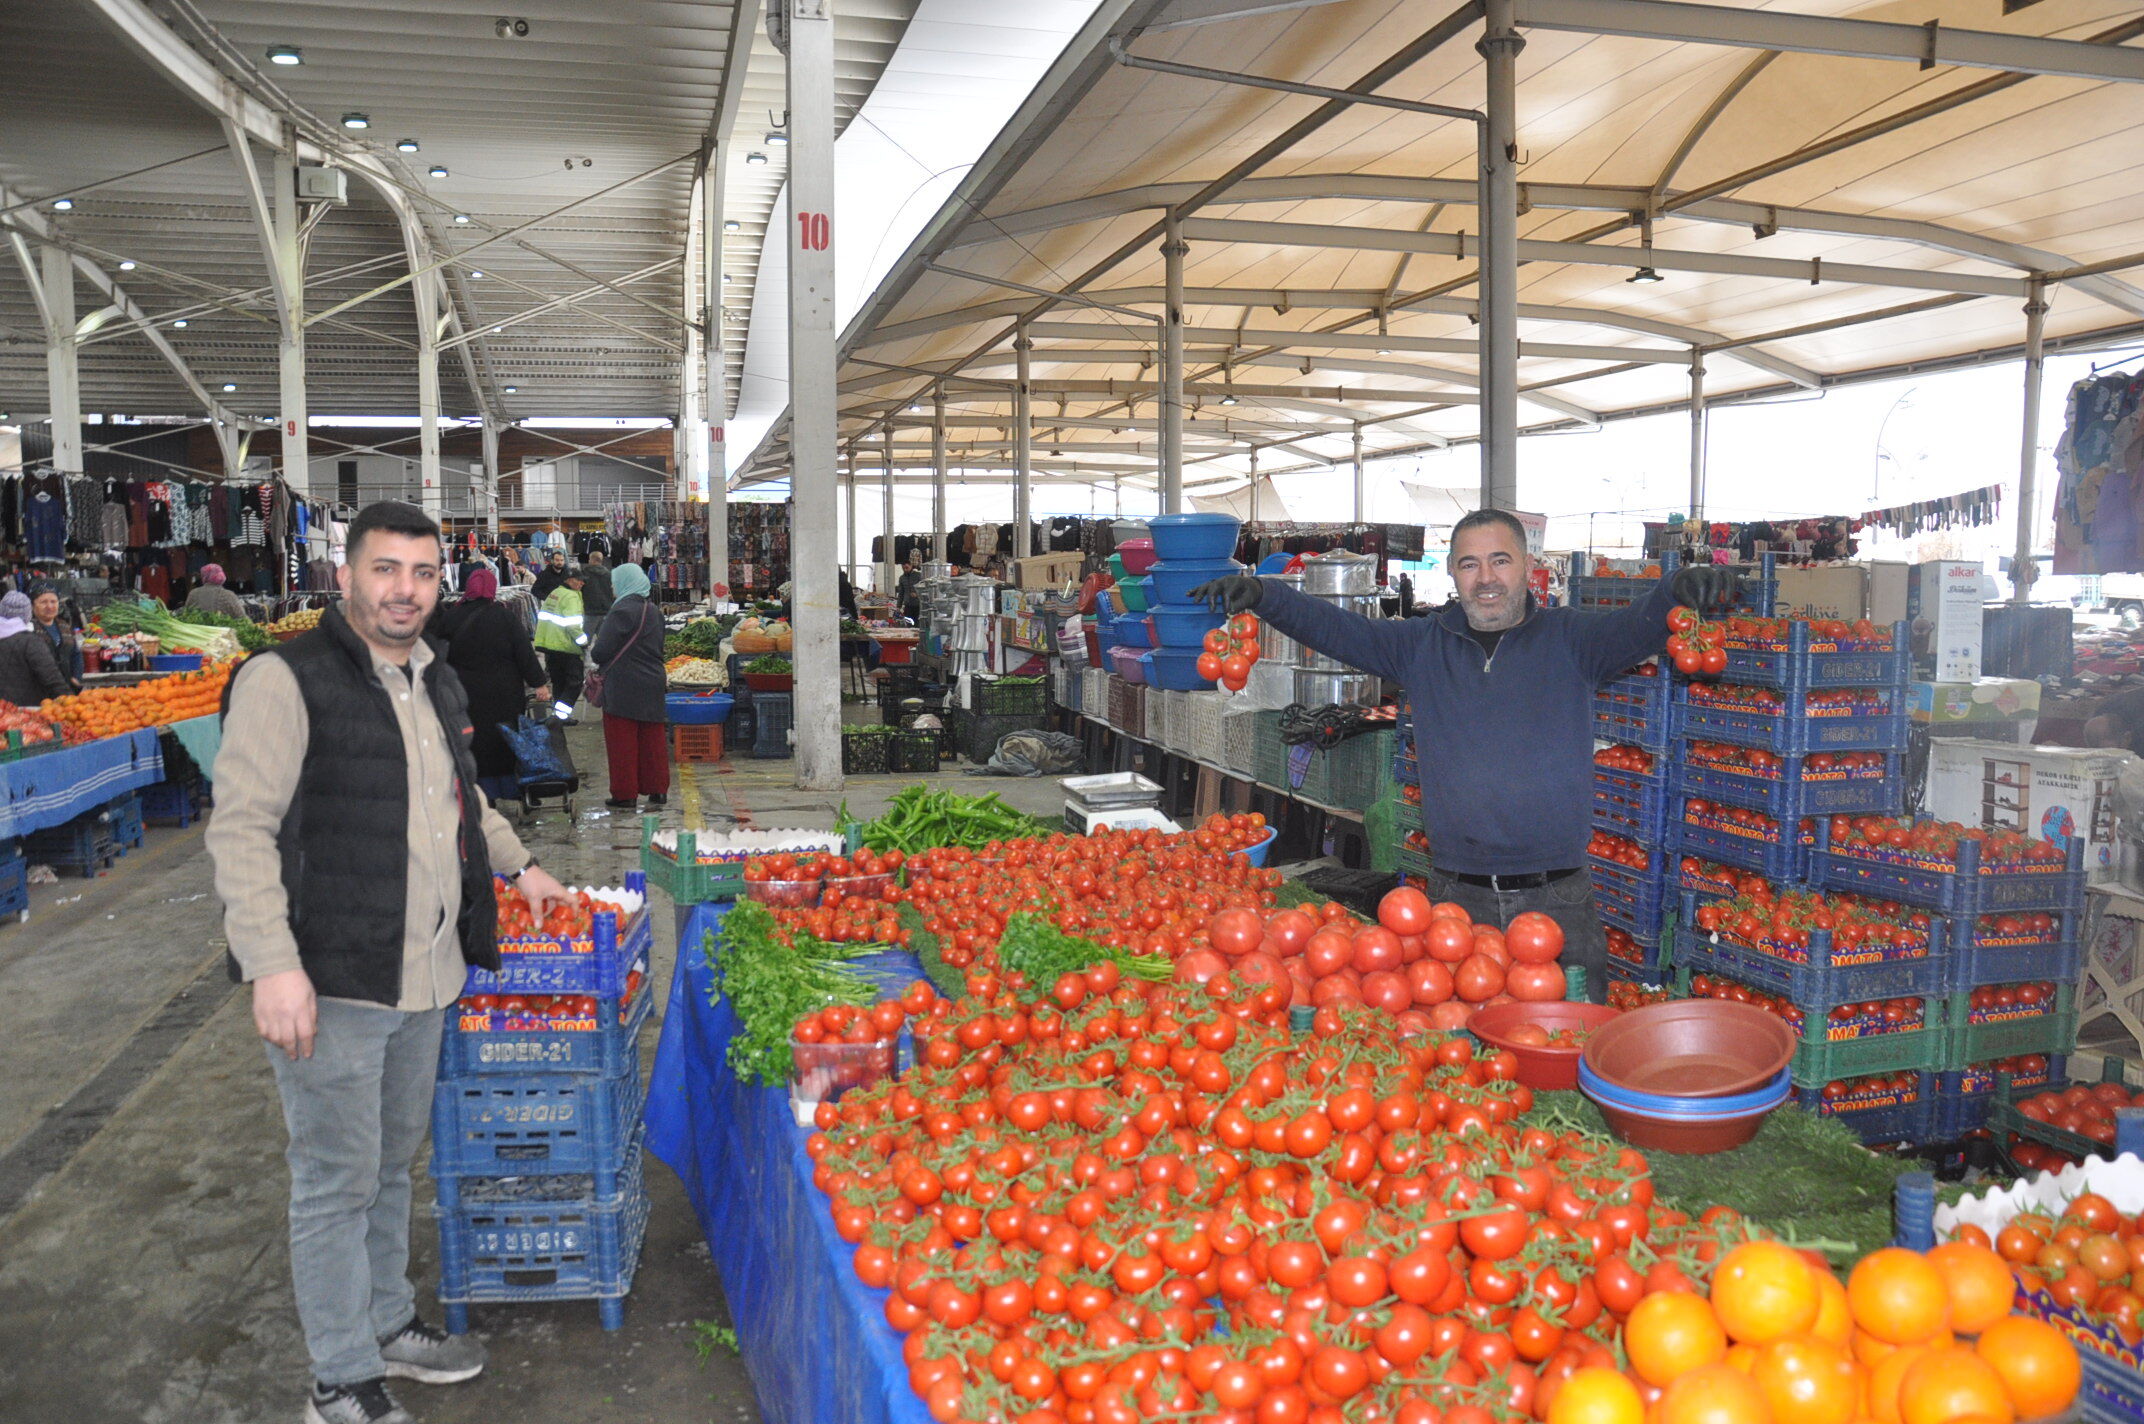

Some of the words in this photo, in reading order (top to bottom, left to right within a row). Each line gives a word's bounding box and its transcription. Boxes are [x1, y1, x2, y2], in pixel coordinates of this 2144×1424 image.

[798, 211, 829, 251] 10
[287, 420, 296, 437] 9
[710, 426, 723, 442] 10
[689, 481, 698, 491] 10
[1947, 566, 1977, 577] alkar
[479, 1042, 571, 1062] GIDER-21
